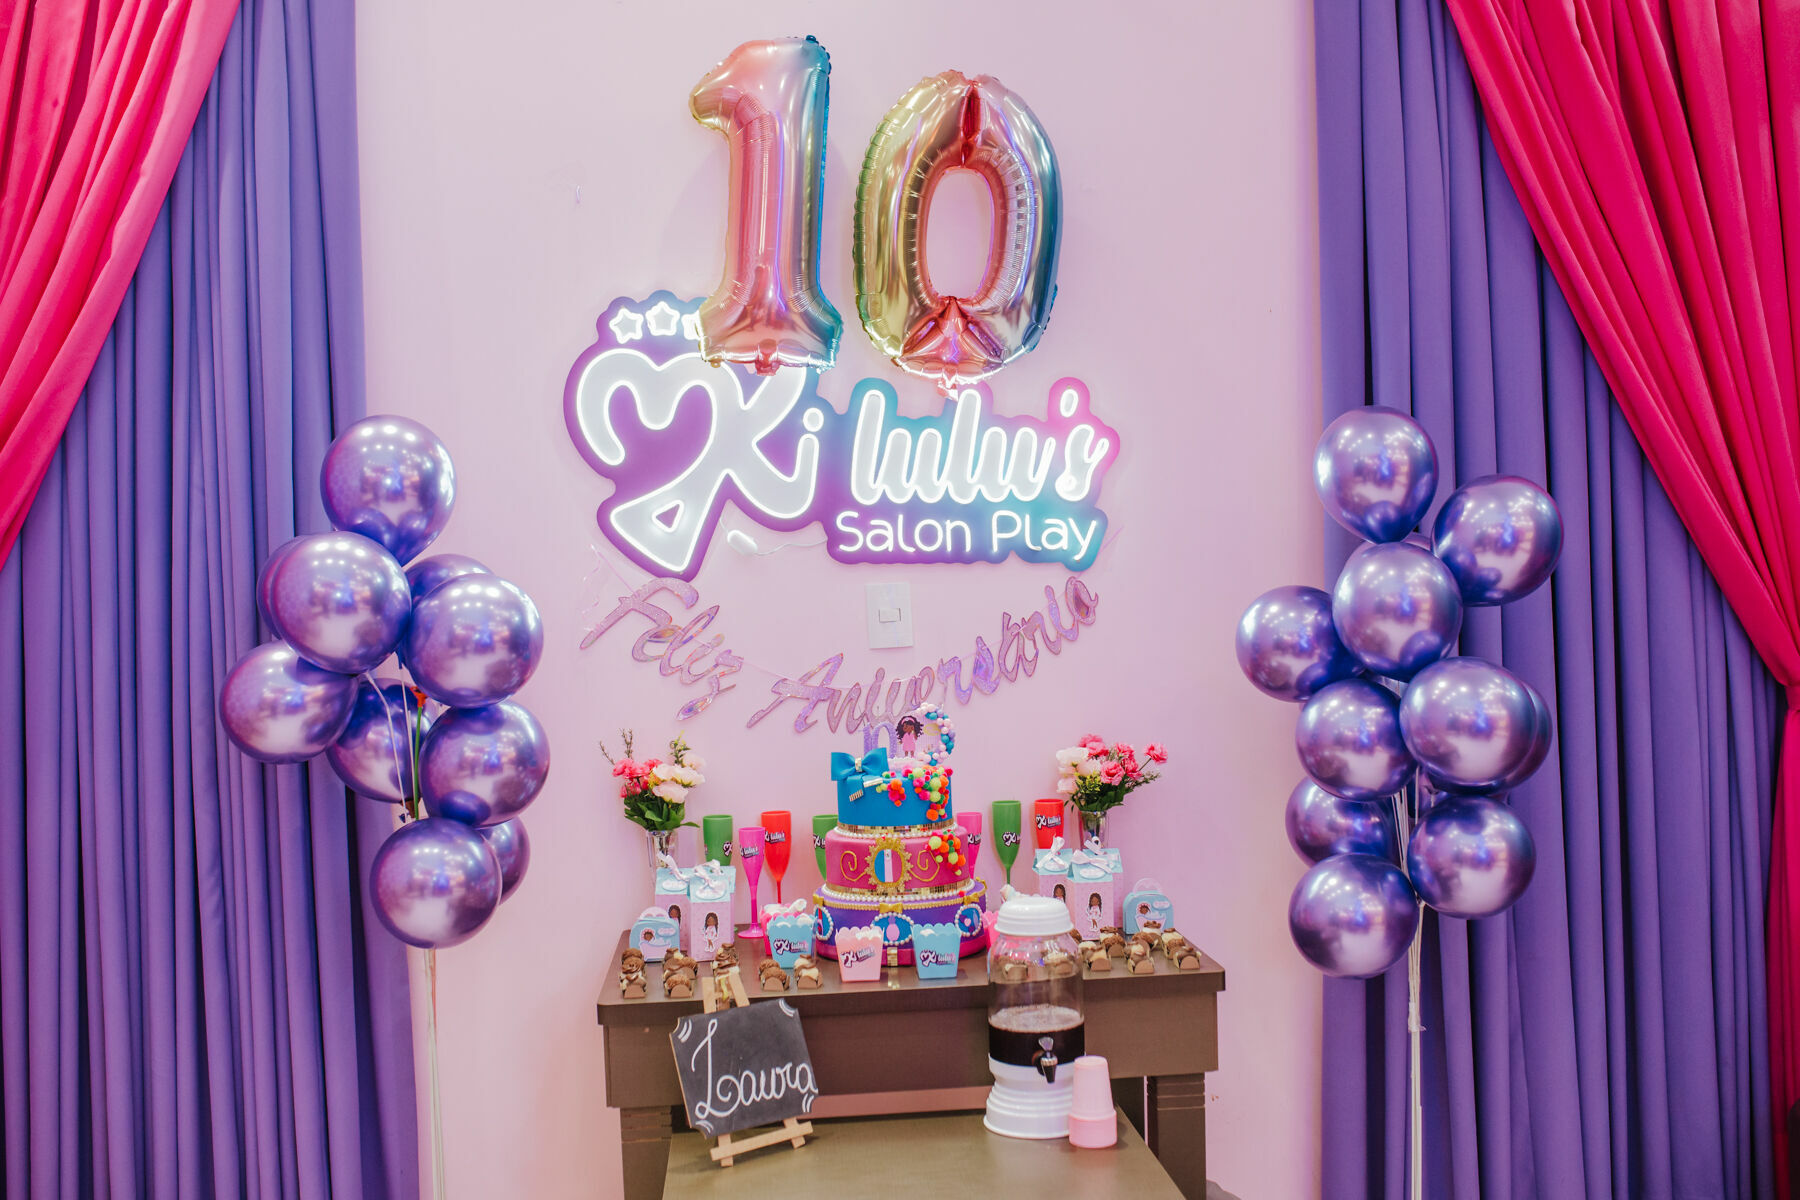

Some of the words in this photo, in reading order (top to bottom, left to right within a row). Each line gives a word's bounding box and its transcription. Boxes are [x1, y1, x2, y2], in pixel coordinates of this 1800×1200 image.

[689, 34, 1065, 390] 10
[835, 510, 972, 553] Salon
[991, 510, 1098, 562] Play
[579, 577, 744, 721] Feliz
[691, 1018, 819, 1119] Laura
